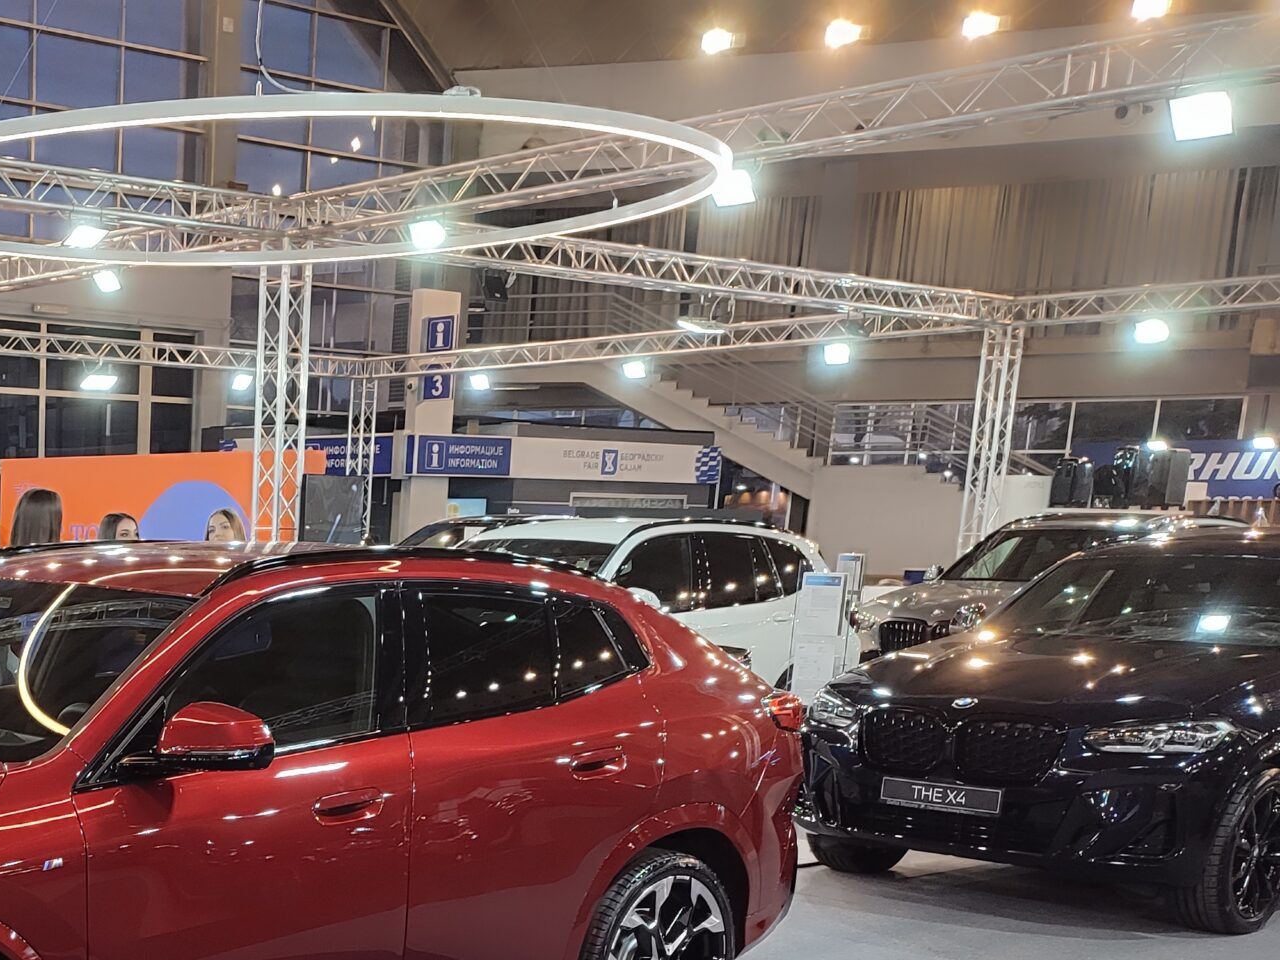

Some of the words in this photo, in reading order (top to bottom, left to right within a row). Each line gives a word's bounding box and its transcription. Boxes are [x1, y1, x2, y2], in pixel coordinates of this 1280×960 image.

[431, 374, 443, 396] 3
[448, 444, 504, 456] ИНФОРМАЦИЈЕ
[563, 450, 600, 459] BELGRADE
[448, 458, 498, 469] INFORMATION
[583, 461, 599, 470] FAIR
[911, 785, 943, 802] THE
[945, 789, 966, 805] X4
